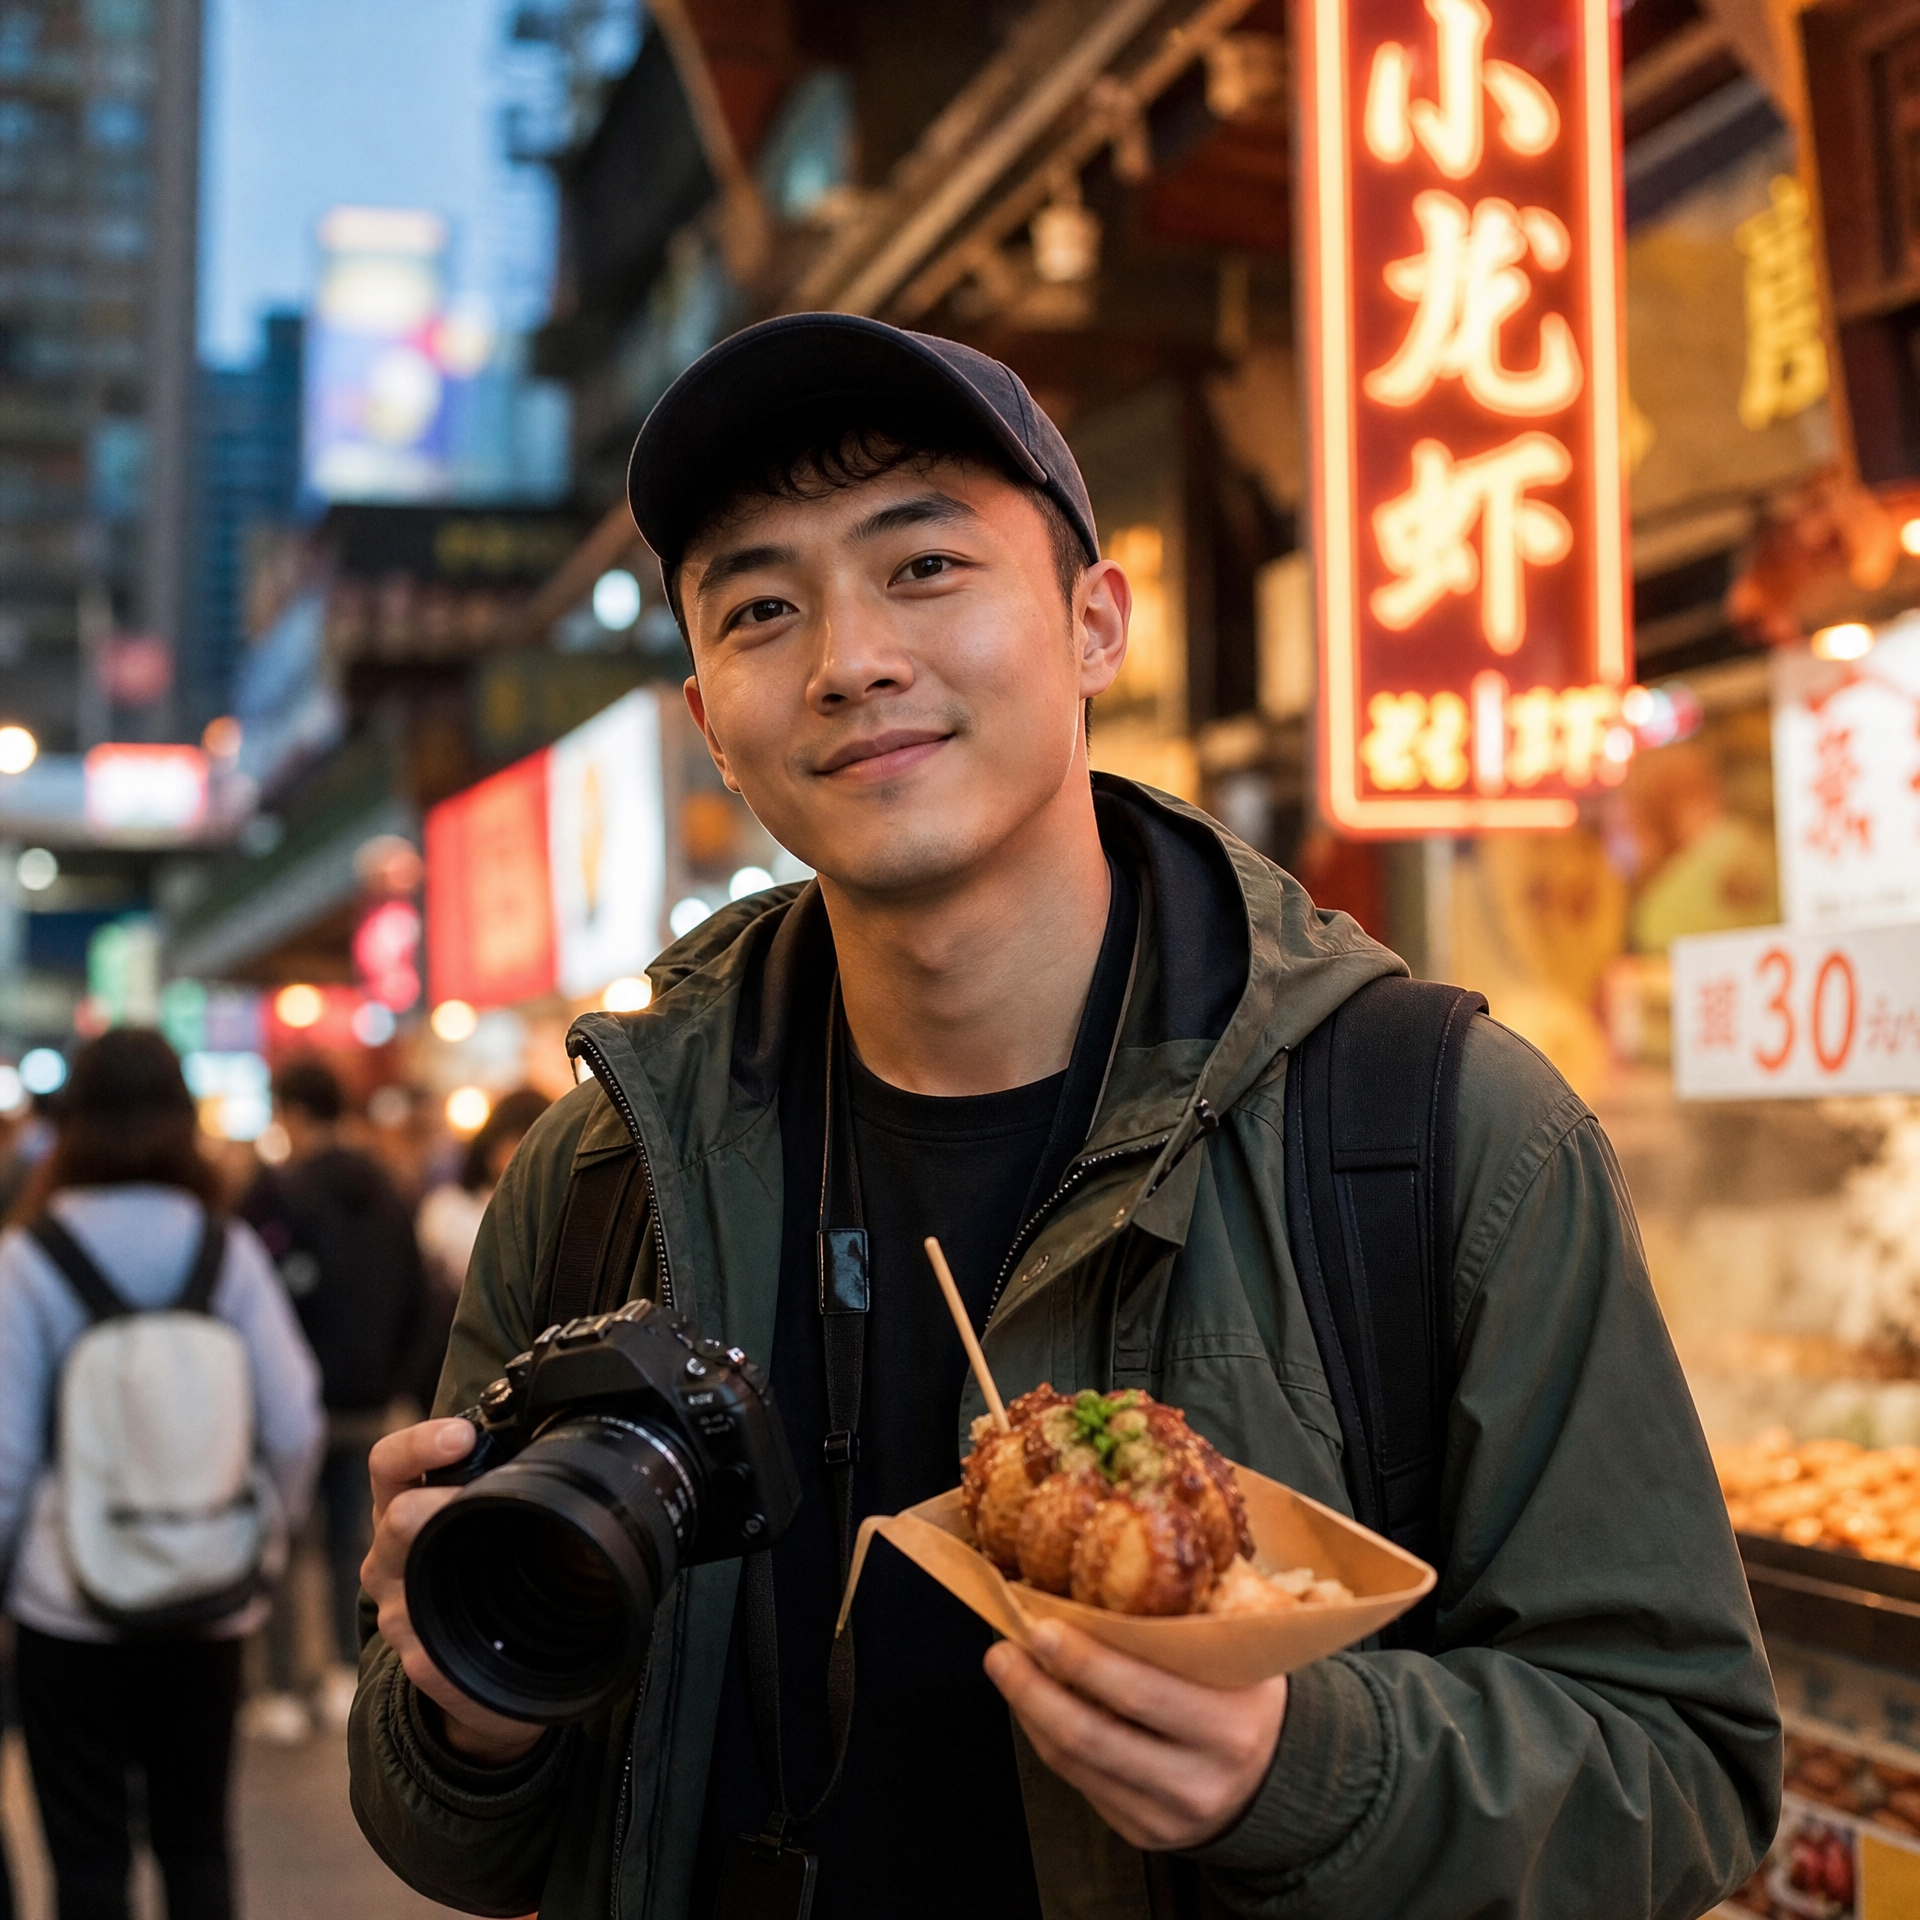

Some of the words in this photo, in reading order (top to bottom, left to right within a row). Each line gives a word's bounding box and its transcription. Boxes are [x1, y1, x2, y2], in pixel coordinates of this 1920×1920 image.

[1364, 0, 1583, 655] 小龙虾
[1754, 947, 1859, 1074] 30
